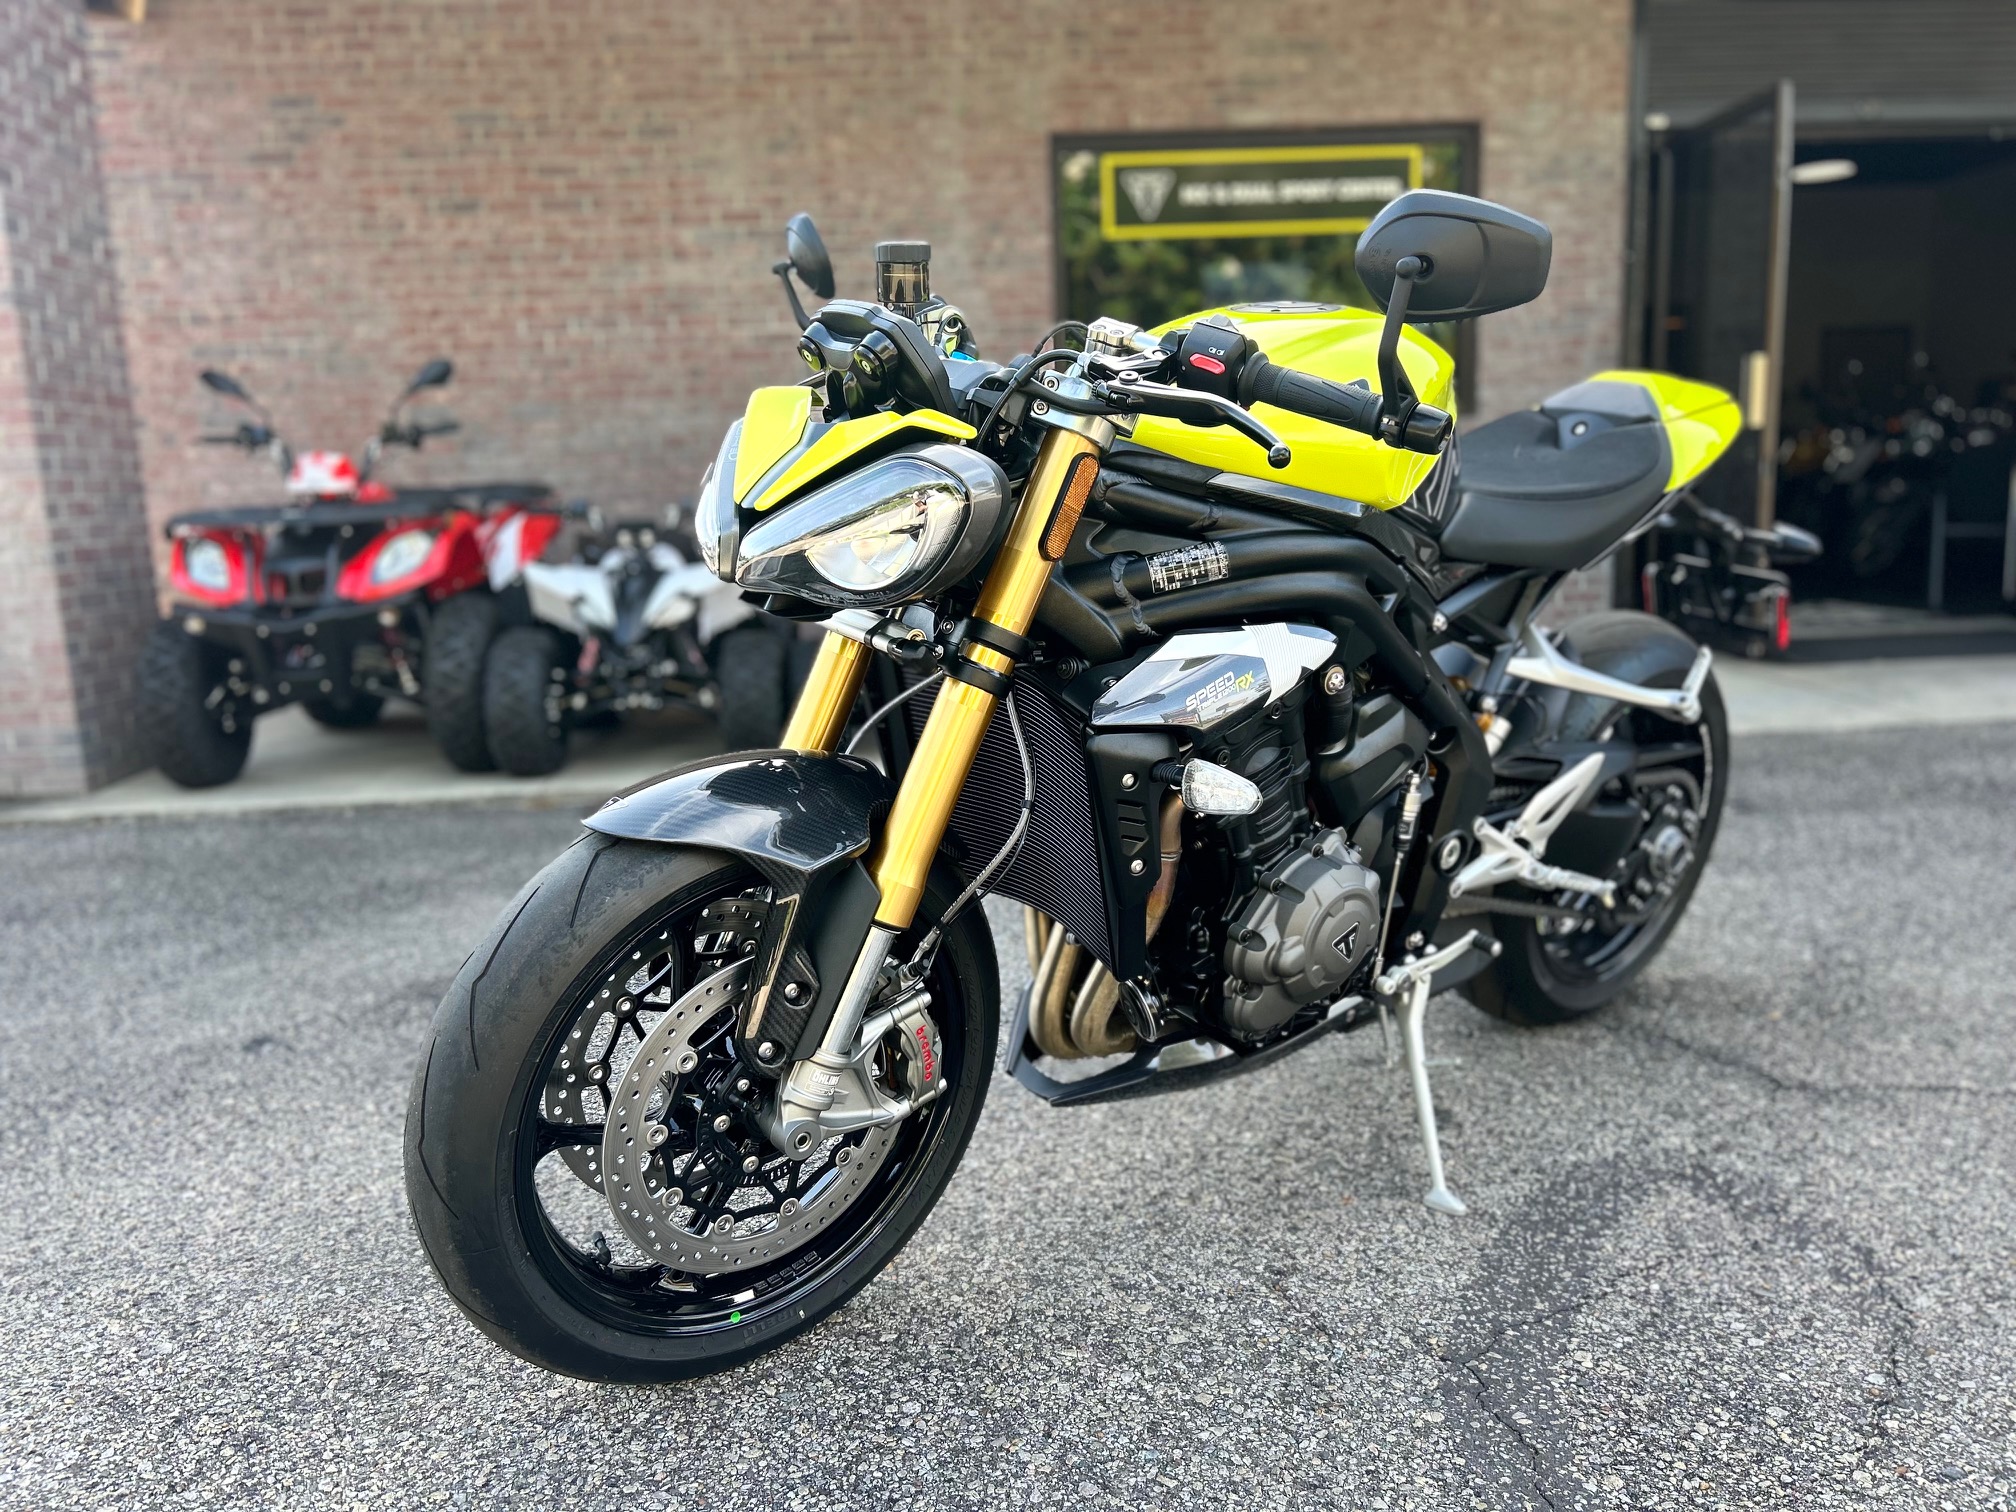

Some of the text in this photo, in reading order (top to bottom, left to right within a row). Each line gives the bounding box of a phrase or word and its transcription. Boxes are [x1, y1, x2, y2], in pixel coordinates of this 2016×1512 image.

[1186, 671, 1235, 711] SPEED
[1235, 670, 1255, 692] RX
[916, 1025, 935, 1081] brembo
